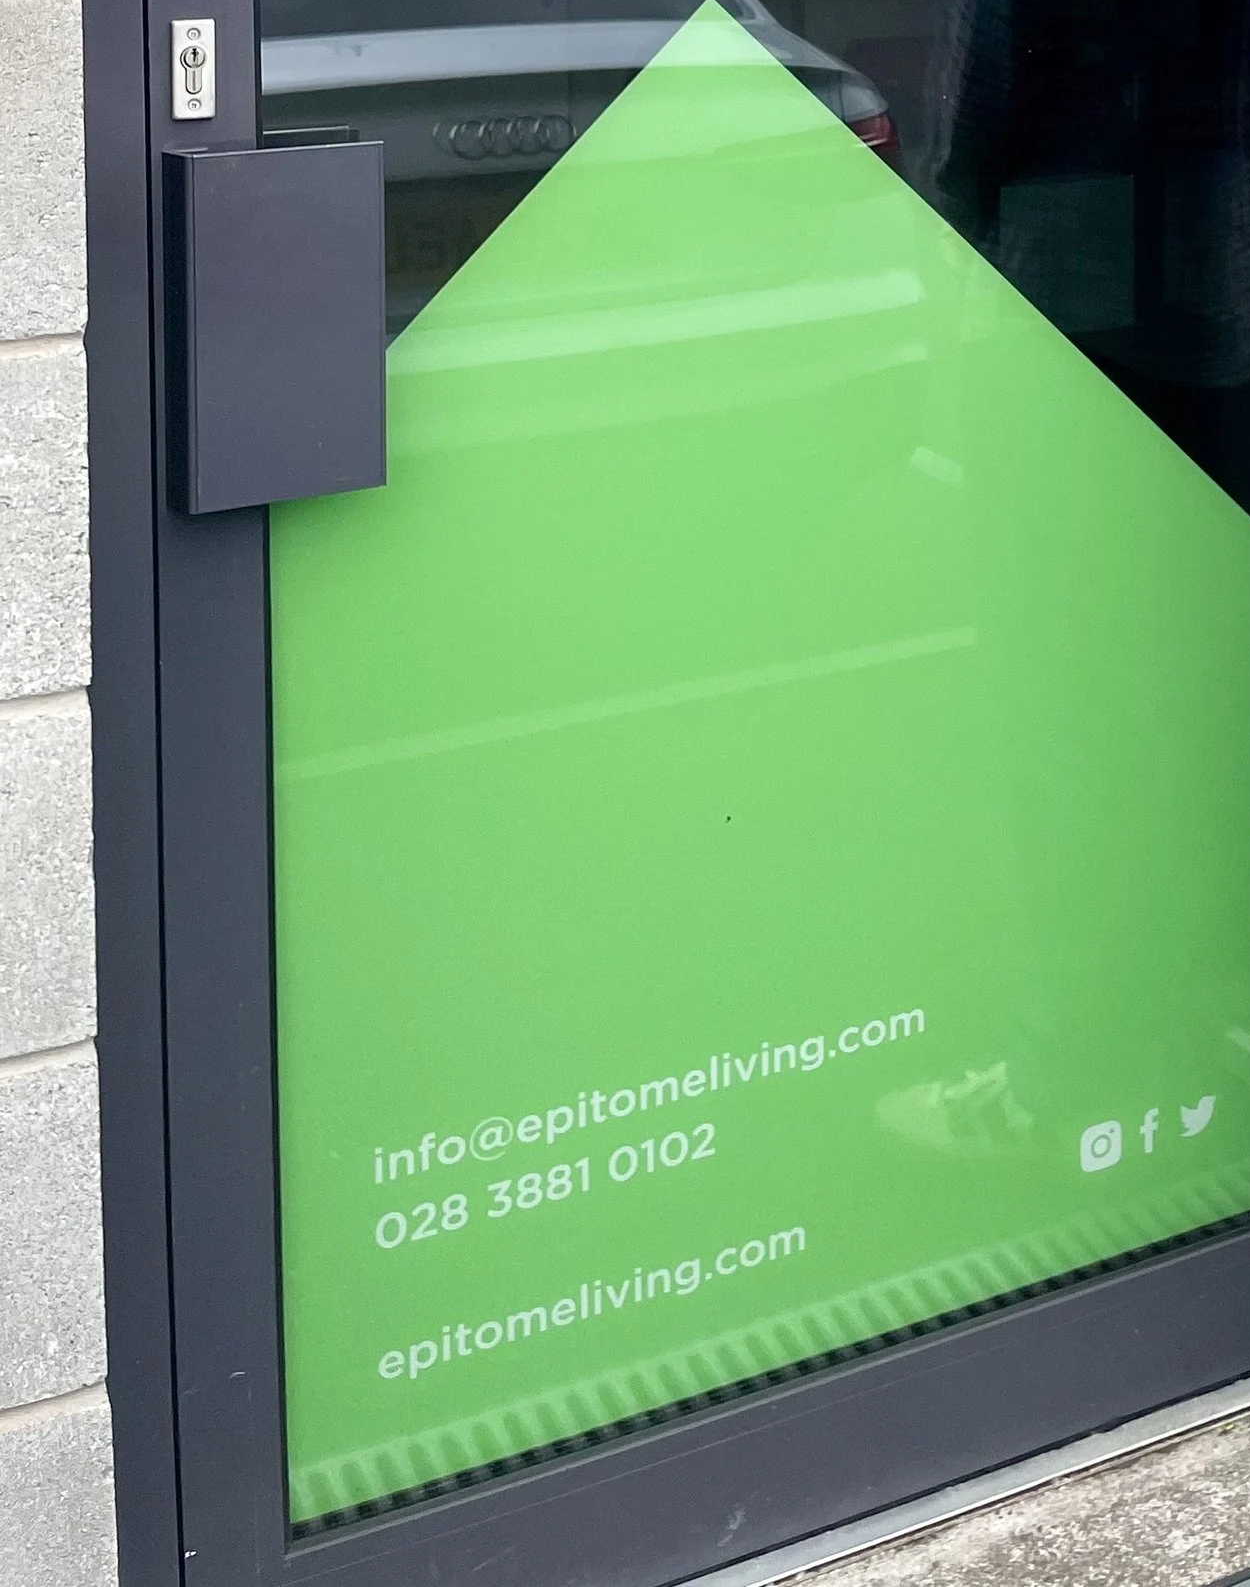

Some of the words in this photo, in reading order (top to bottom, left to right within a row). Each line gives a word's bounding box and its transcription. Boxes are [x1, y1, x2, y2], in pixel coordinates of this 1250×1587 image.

[374, 1008, 925, 1184] info@epitomeliving.com
[375, 1194, 469, 1249] 028
[487, 1157, 590, 1218] 3881
[608, 1123, 716, 1183] 0102
[377, 1226, 806, 1379] epitomeliving.com
